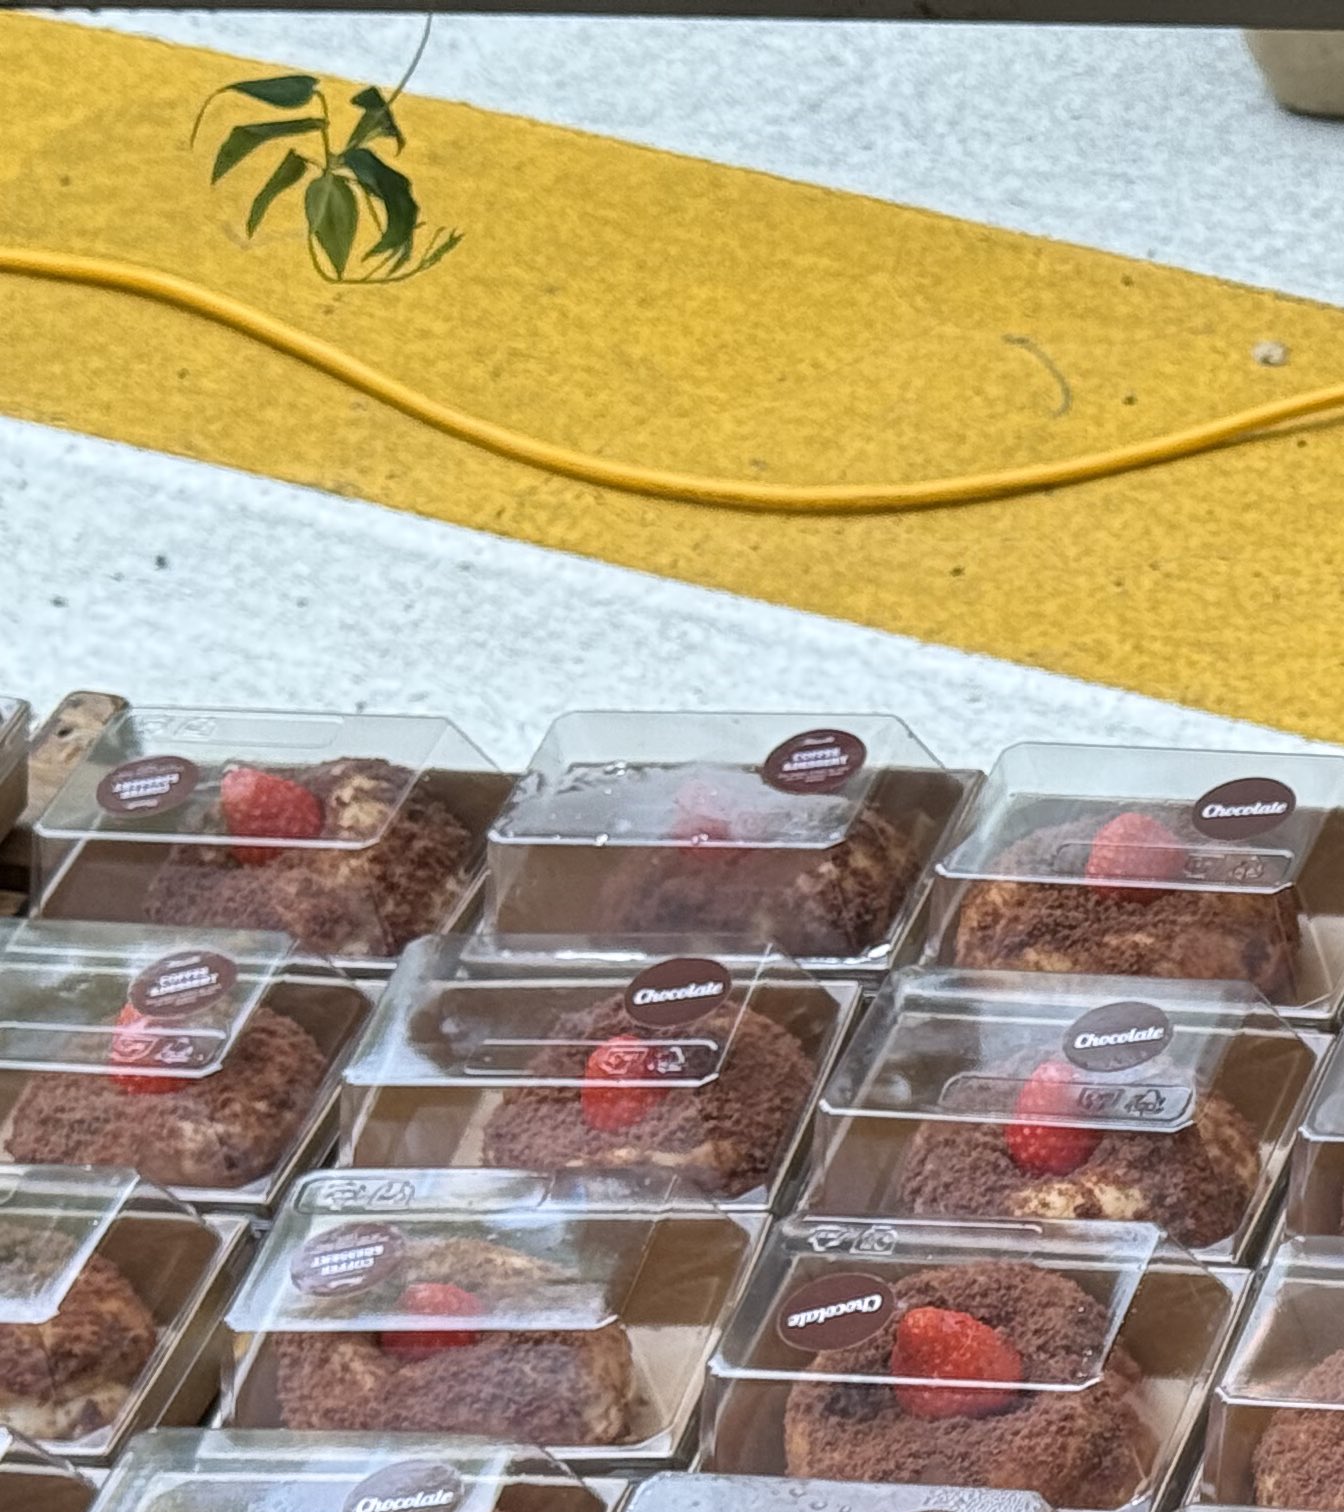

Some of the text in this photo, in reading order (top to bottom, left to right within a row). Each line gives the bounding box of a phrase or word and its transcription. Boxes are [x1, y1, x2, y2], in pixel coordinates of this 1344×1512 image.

[1202, 802, 1287, 818] Chocolate
[633, 982, 723, 1004] Chocolate
[1075, 1026, 1164, 1048] Chocolate
[788, 1294, 882, 1327] Chocolate
